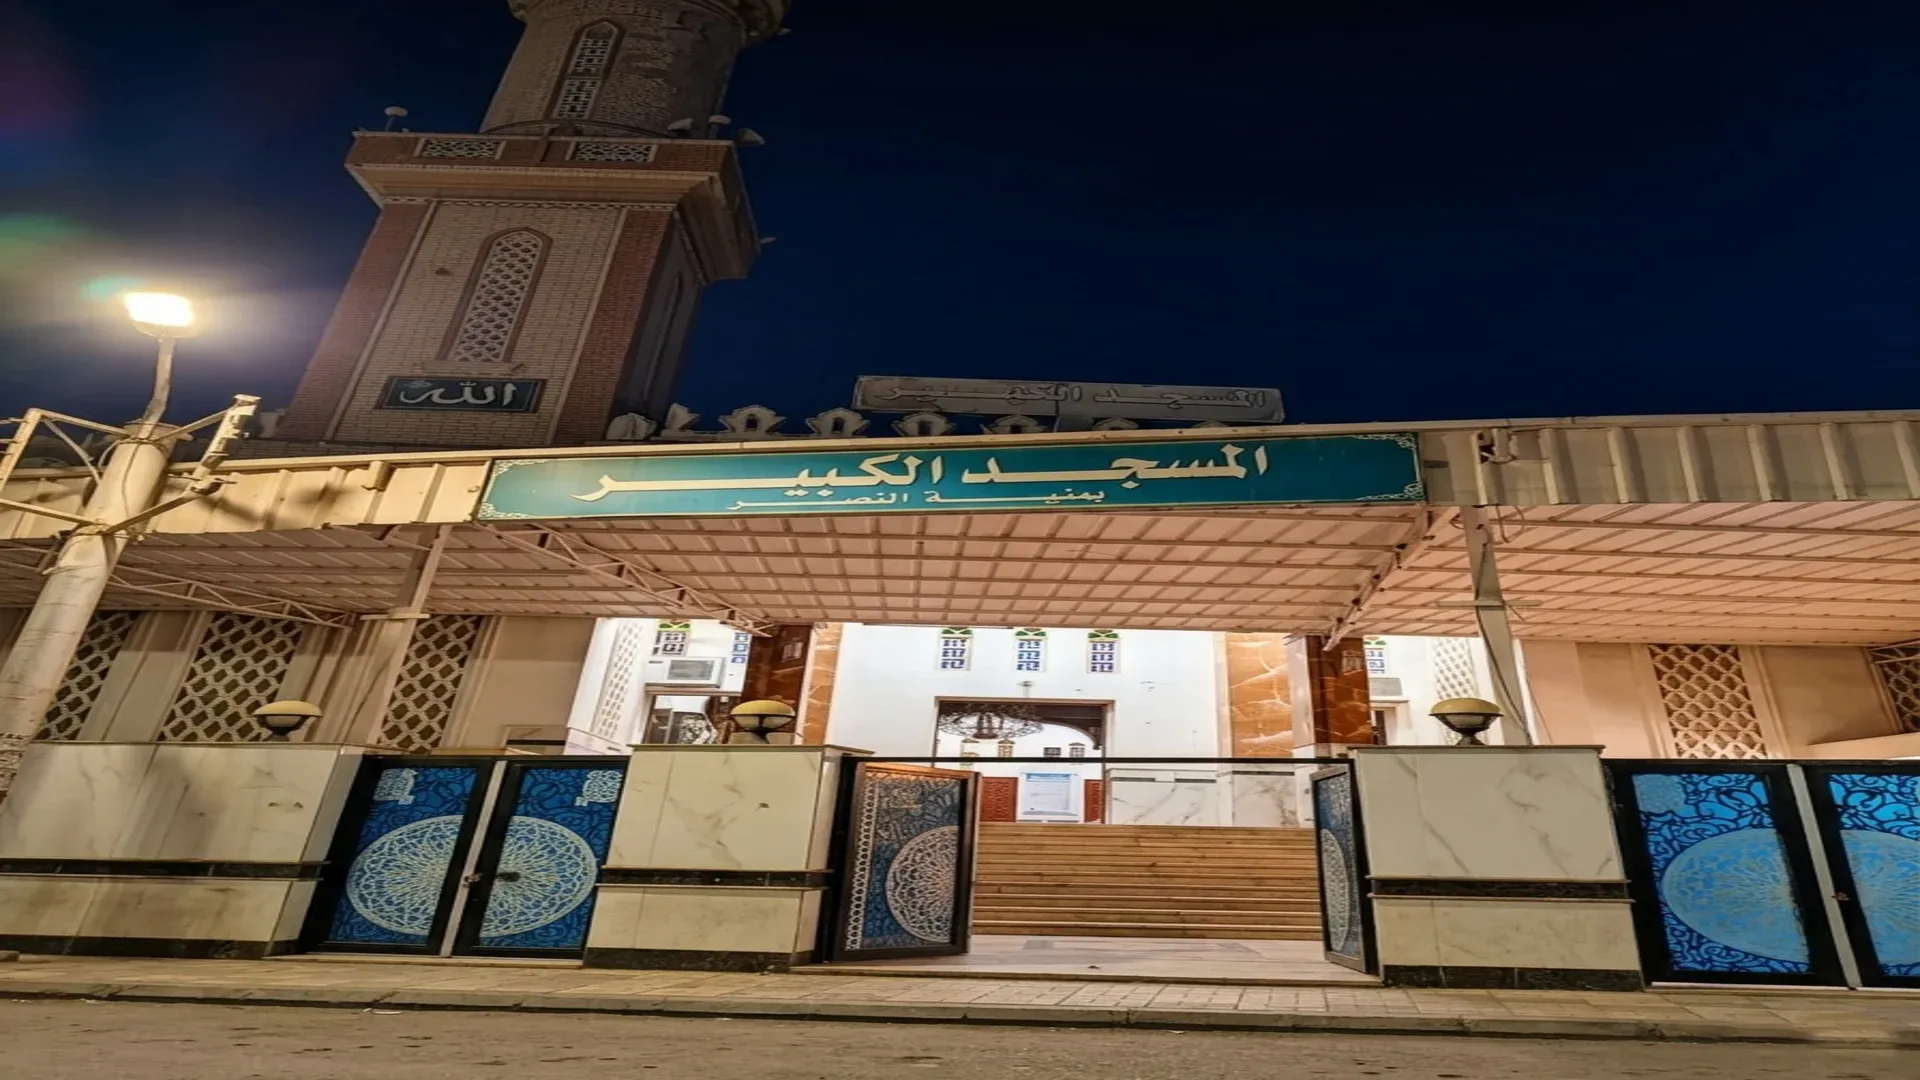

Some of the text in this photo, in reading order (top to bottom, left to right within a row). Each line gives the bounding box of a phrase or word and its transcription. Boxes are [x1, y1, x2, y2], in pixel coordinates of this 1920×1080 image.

[400, 381, 517, 406] الله
[570, 443, 1268, 502] المسجد الكبير
[725, 491, 908, 511] النصر
